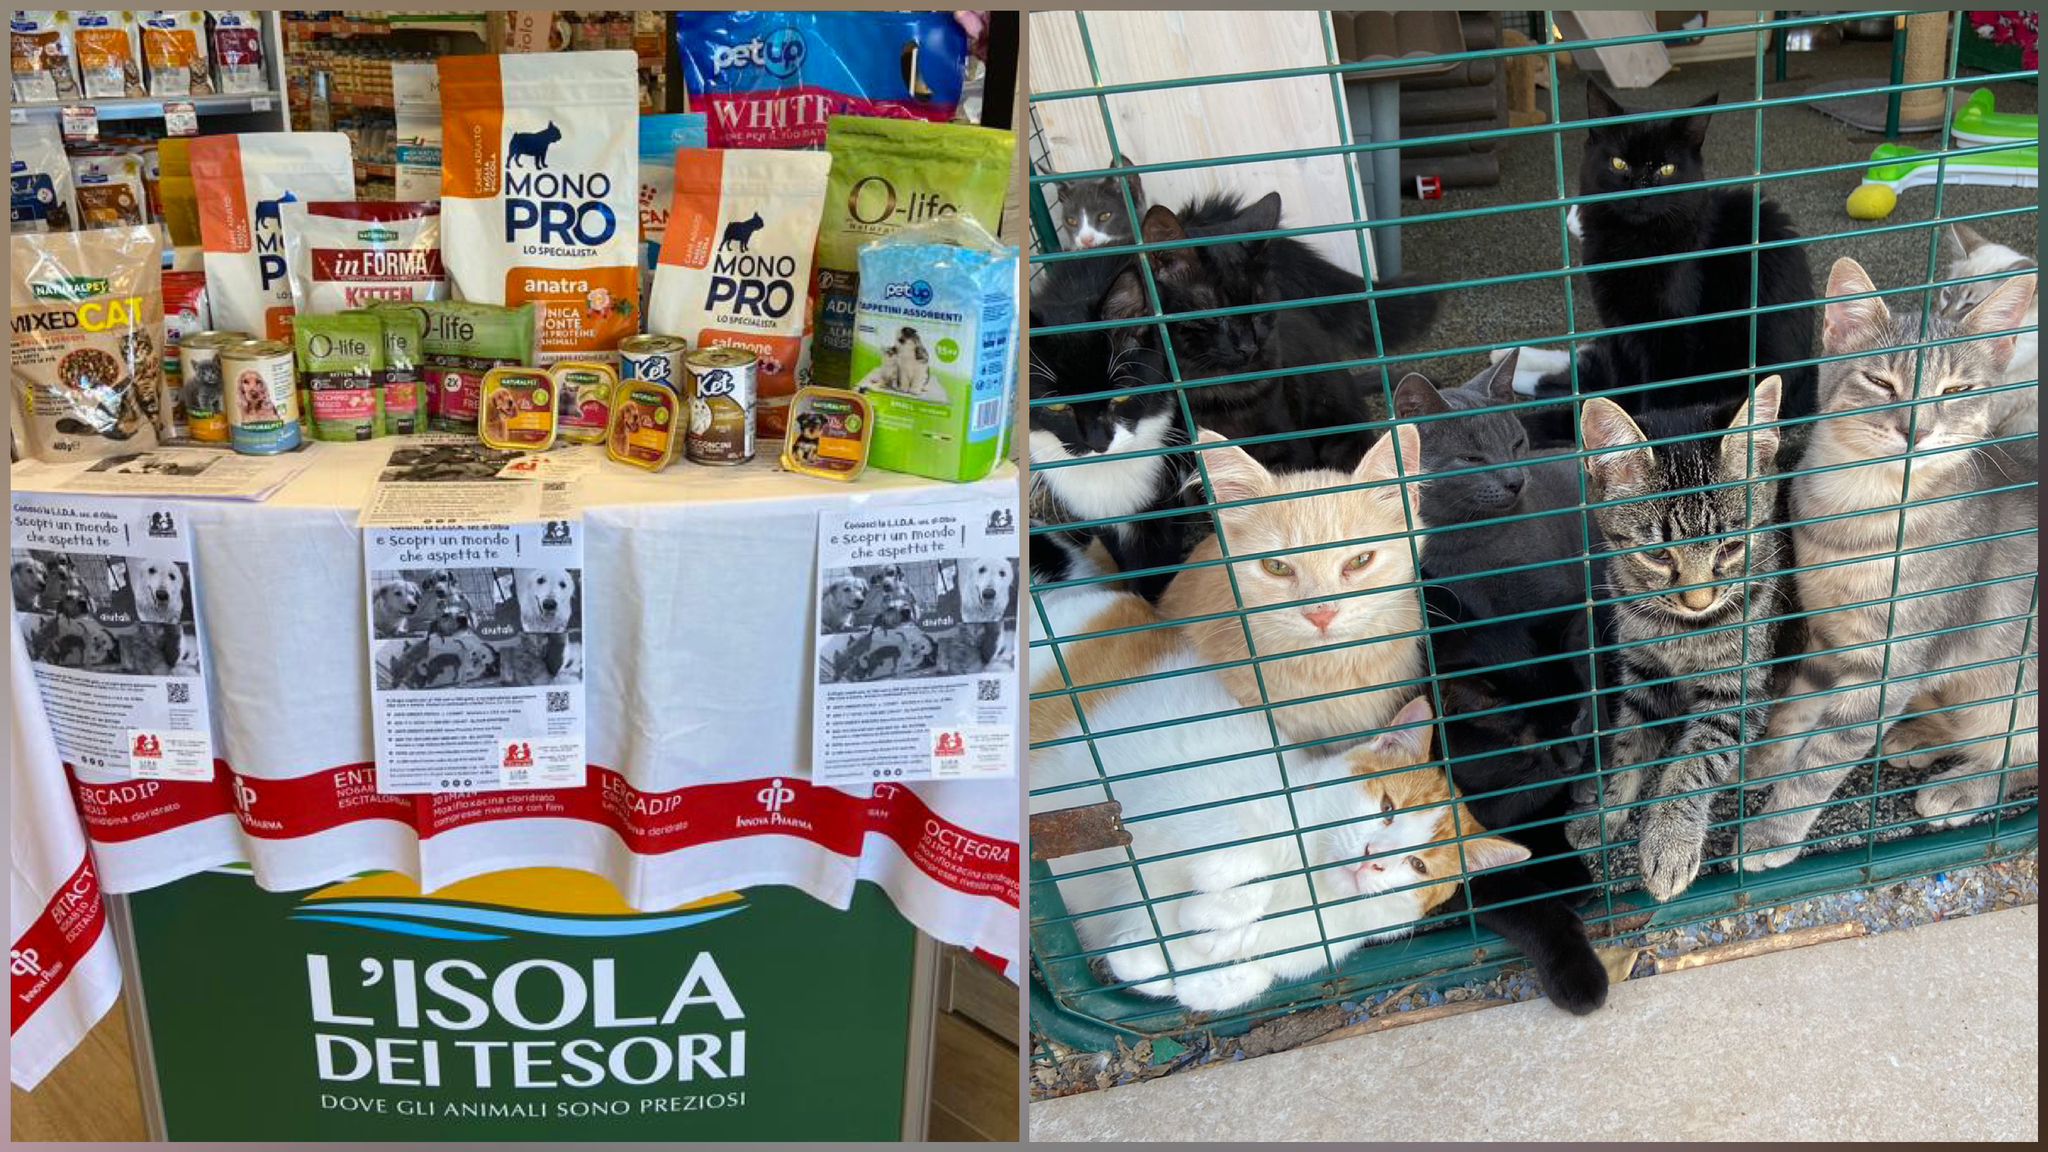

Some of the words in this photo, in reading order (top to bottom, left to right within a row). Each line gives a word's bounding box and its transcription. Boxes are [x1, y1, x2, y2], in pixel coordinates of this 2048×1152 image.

[505, 173, 611, 198] MONO
[506, 198, 616, 246] PRO
[523, 245, 537, 256] LO
[538, 246, 598, 258] SPECIALISTA
[363, 251, 428, 276] FORMA
[713, 254, 796, 278] MONO
[525, 278, 588, 294] anatra
[704, 276, 795, 319] PRO
[716, 315, 729, 324] LO
[730, 316, 777, 328] SPECIALISTA
[903, 308, 963, 323] ASSORBENTI
[309, 333, 366, 358] O-life
[697, 370, 734, 397] Ket
[57, 521, 72, 531] un
[75, 521, 118, 534] mondo
[830, 536, 838, 545] e
[890, 532, 908, 541] un
[912, 525, 956, 540] mondo
[27, 531, 44, 544] che
[49, 533, 93, 549] aspetta
[97, 534, 110, 546] te
[376, 536, 385, 545] e
[439, 535, 458, 545] un
[462, 532, 510, 546] mondo
[851, 546, 873, 560] che
[878, 543, 927, 560] aspetta
[932, 540, 945, 552] te
[400, 549, 423, 563] che
[427, 549, 480, 564] aspetta
[484, 549, 499, 560] te
[925, 818, 1010, 863] OCTEGRA
[315, 1033, 441, 1087] DEI
[454, 1030, 746, 1089] TESORI
[320, 1093, 387, 1115] DOVE
[397, 1099, 435, 1117] GLI
[444, 1101, 547, 1118] ANIMALI
[557, 1099, 630, 1118] SONO
[639, 1091, 747, 1115] PREZIOSI
